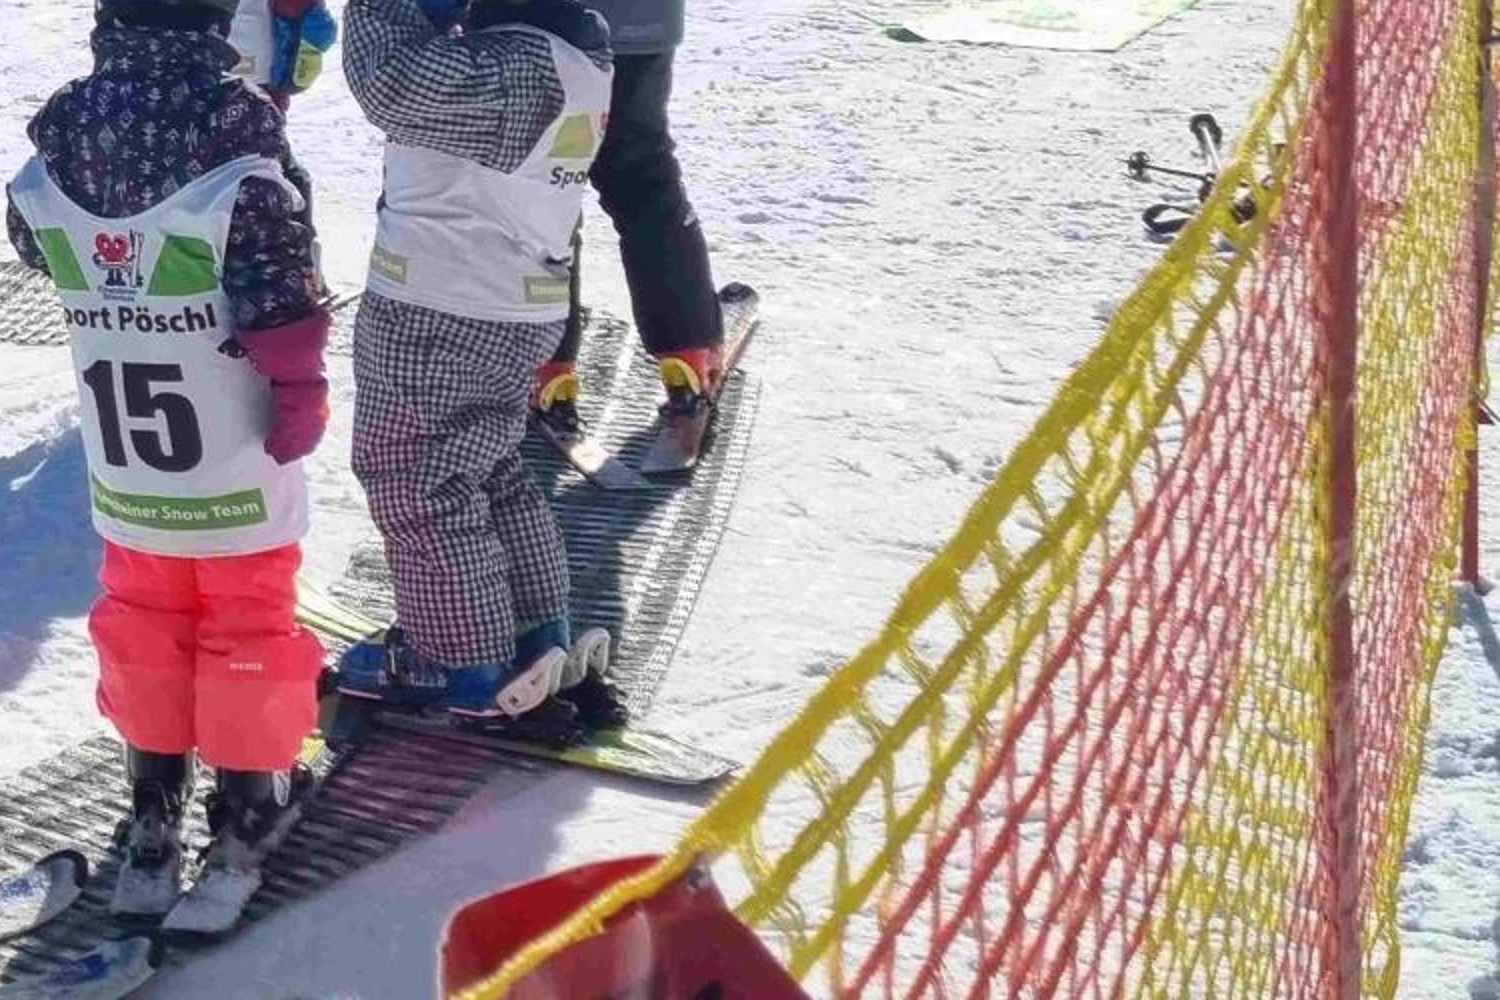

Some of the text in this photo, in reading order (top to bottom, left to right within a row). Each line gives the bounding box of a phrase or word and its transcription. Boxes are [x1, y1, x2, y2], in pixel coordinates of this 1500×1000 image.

[549, 165, 588, 190] Spo
[117, 303, 217, 333] Pöschl
[83, 359, 203, 473] 15
[161, 504, 209, 521] Snow
[211, 501, 260, 519] Team
